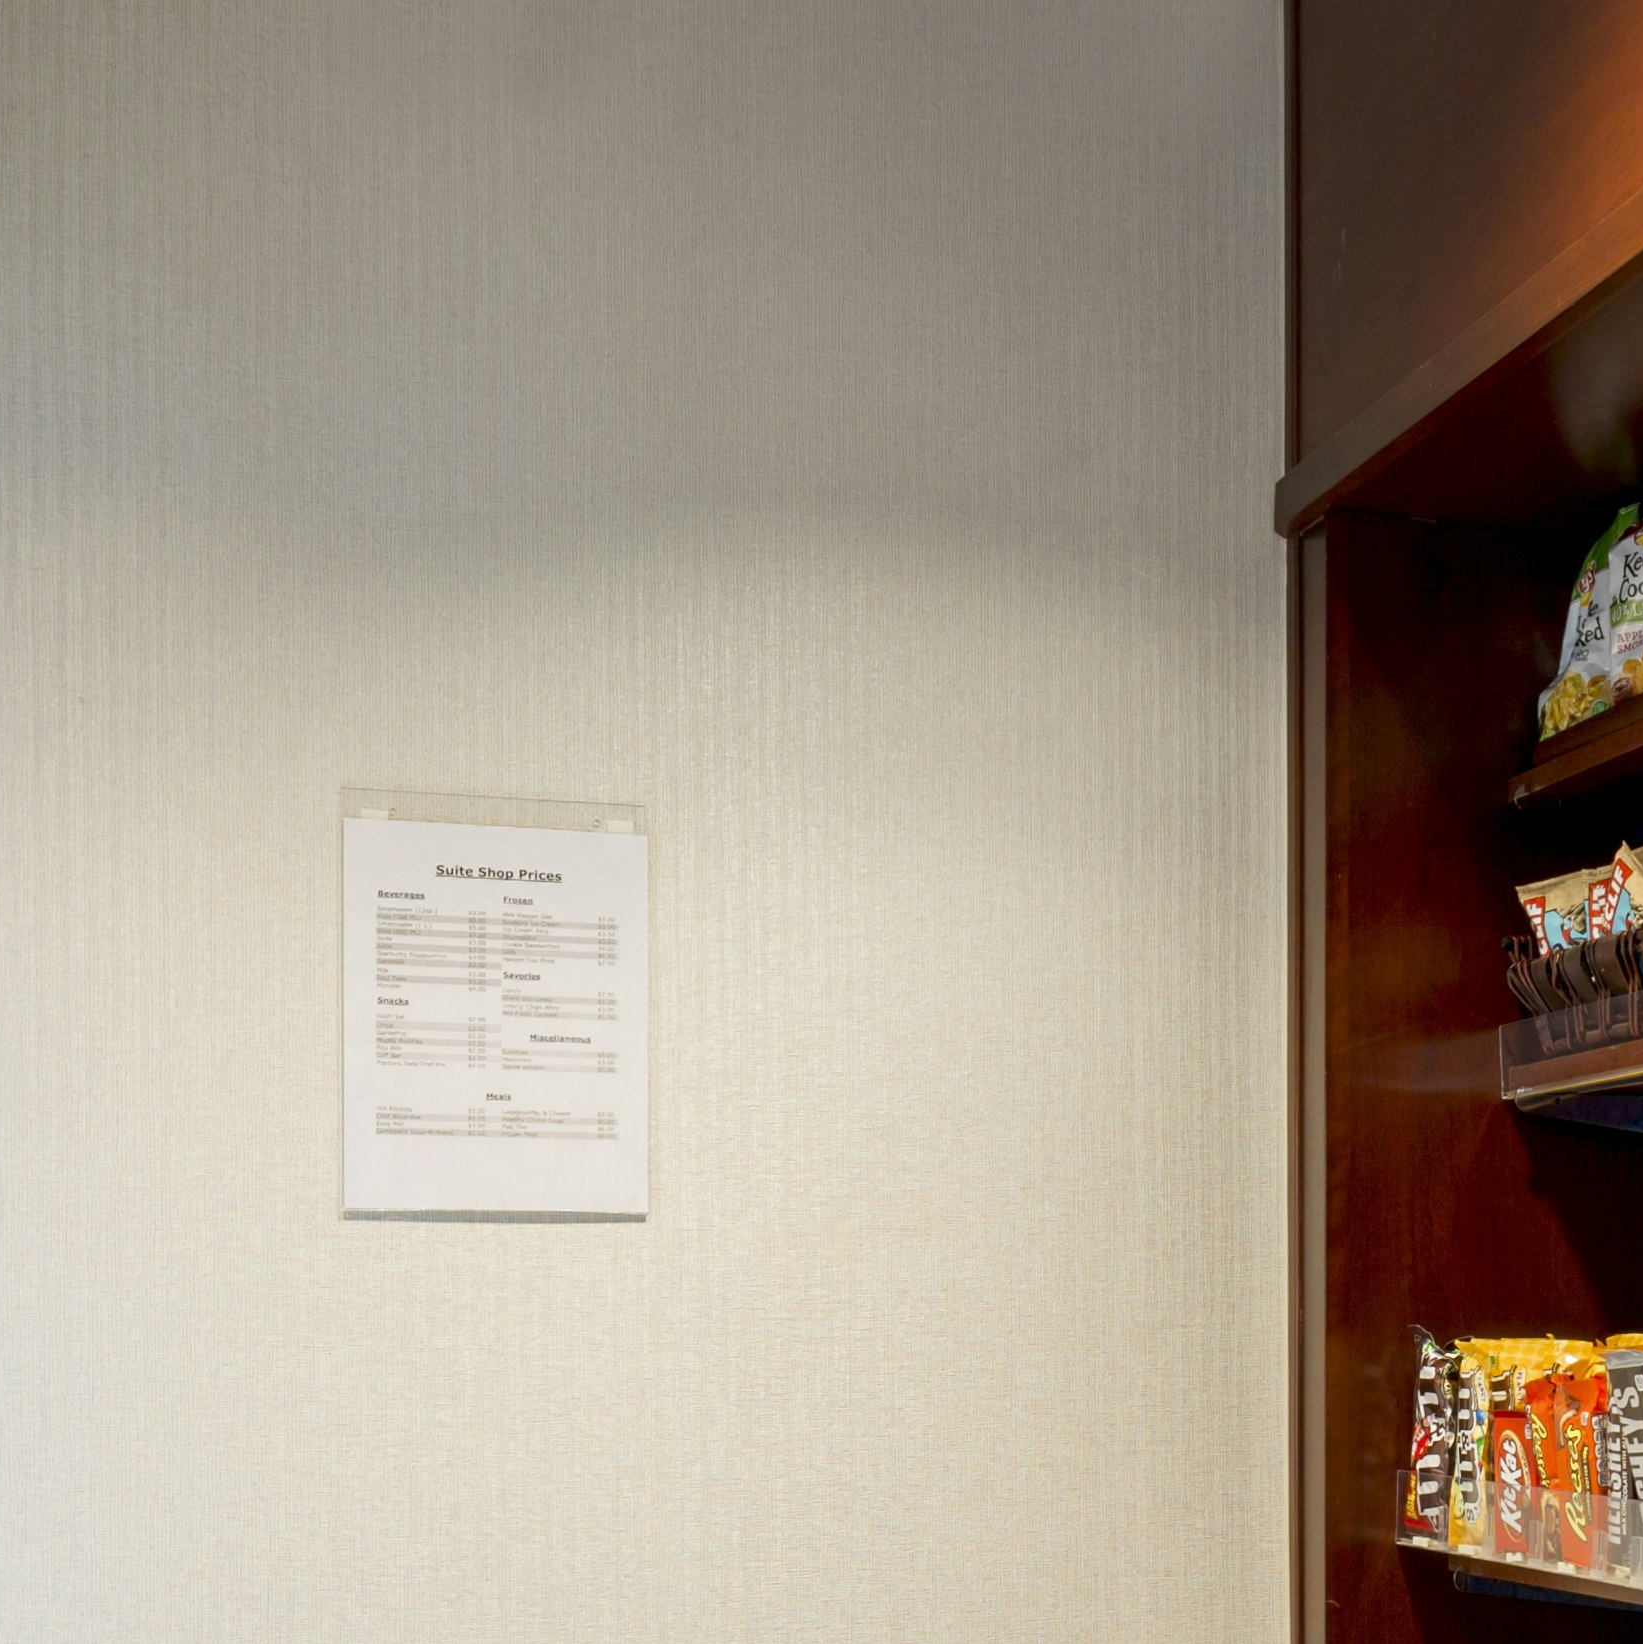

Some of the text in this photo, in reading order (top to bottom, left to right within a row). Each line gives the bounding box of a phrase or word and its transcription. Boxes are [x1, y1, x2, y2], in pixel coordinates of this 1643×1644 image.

[436, 864, 562, 882] Suite Shop Prices
[377, 890, 425, 900] Beverages
[503, 896, 534, 905] Frozen
[1526, 903, 1548, 955] CLIF
[503, 971, 541, 981] Savories
[377, 997, 409, 1006] Snacks
[530, 1034, 591, 1044] Miscellaneous
[486, 1093, 511, 1102] Meals
[1564, 1424, 1589, 1544] Reese's
